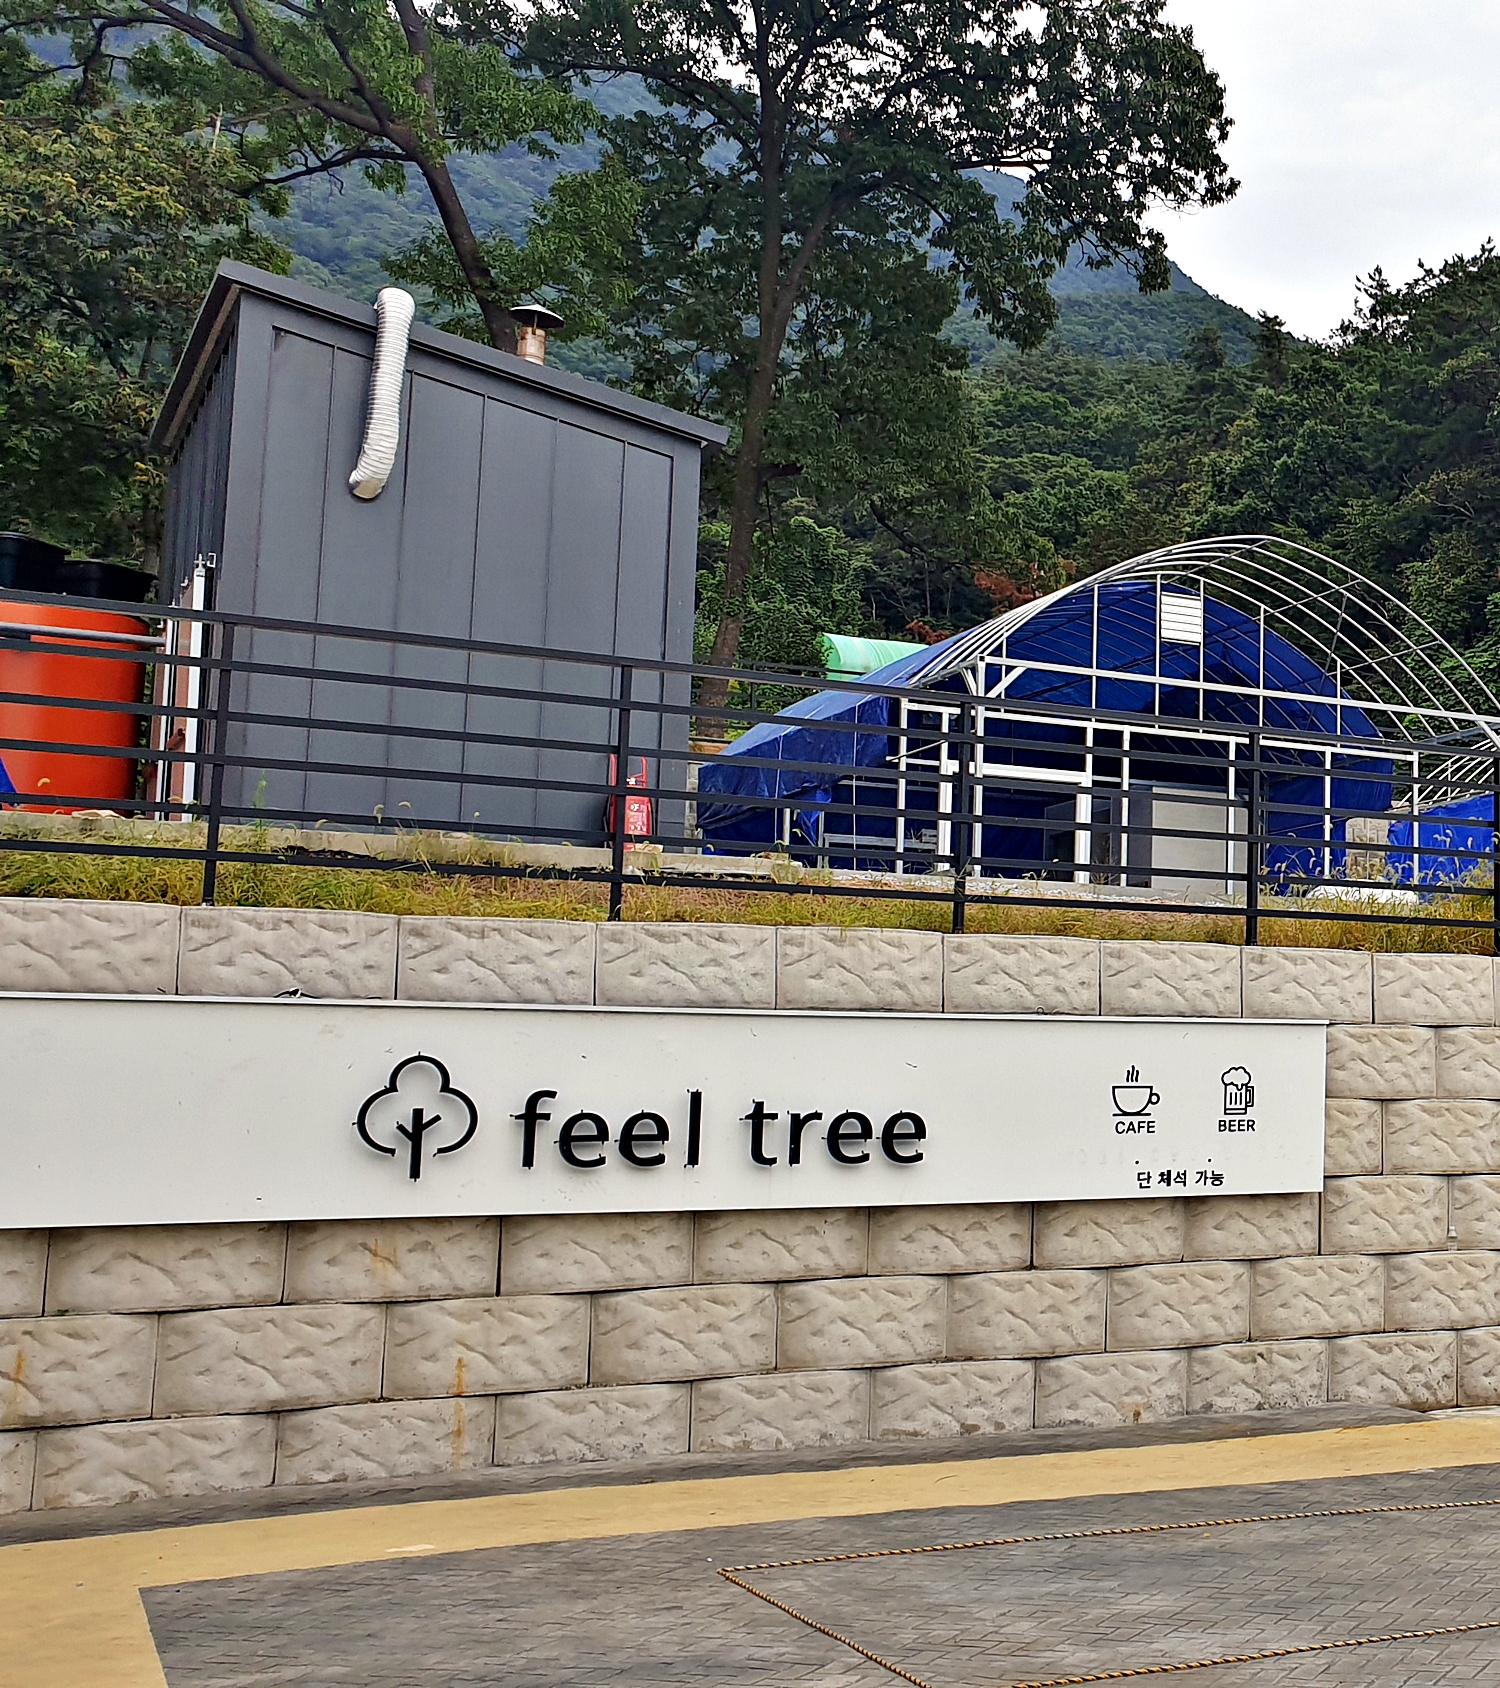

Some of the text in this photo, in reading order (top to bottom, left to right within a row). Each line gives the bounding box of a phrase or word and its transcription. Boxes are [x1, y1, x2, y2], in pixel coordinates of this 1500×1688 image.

[512, 1088, 927, 1169] feel tree
[1114, 1120, 1156, 1134] CAFE
[1218, 1119, 1256, 1132] BEER
[1194, 1169, 1225, 1186] 가능
